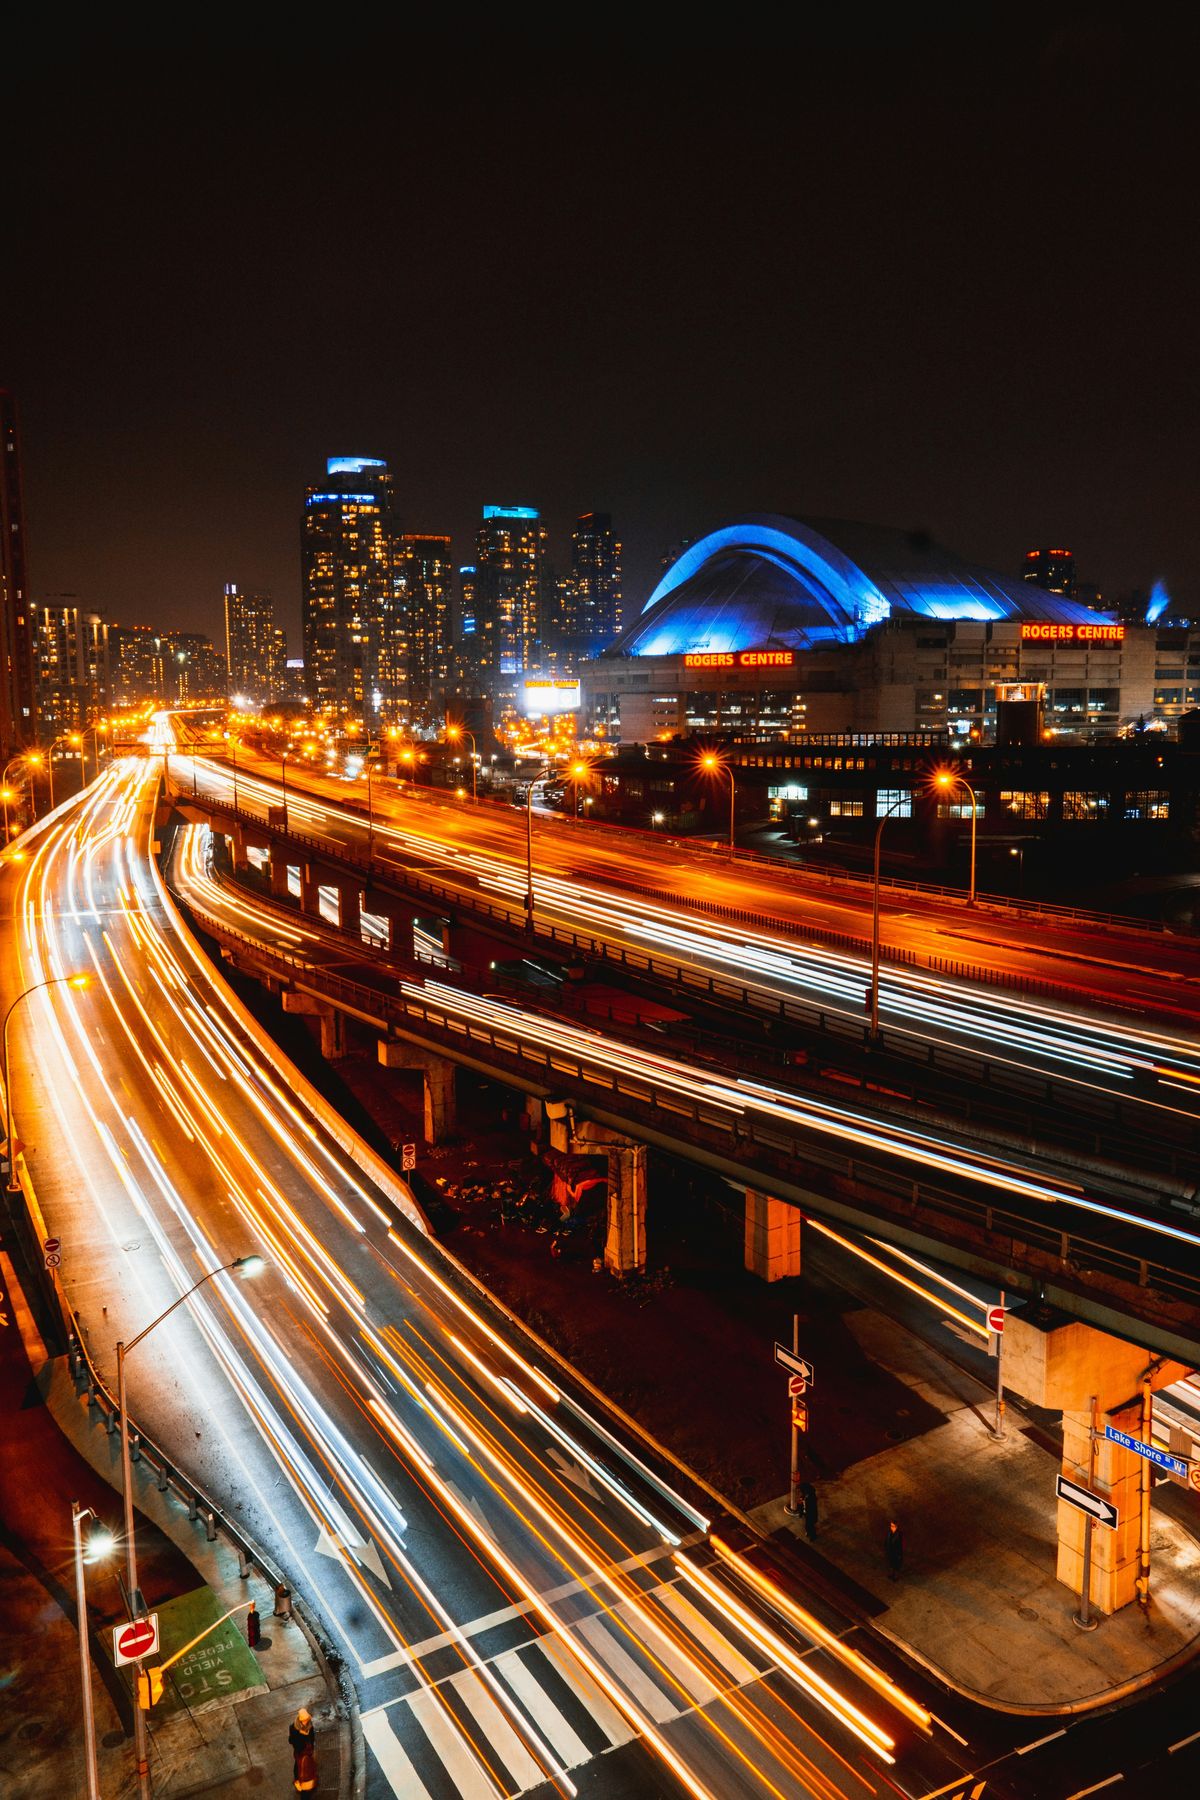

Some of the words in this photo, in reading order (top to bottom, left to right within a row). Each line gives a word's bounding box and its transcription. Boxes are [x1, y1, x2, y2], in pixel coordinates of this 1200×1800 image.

[1022, 624, 1073, 638] ROGERS
[1077, 626, 1124, 639] CENTRE
[685, 654, 734, 666] ROGERS
[740, 653, 792, 665] CENTRE
[1109, 1428, 1131, 1447] Lake
[1134, 1441, 1162, 1462] Shore
[1173, 1460, 1182, 1472] W
[183, 1657, 223, 1676] YIELD
